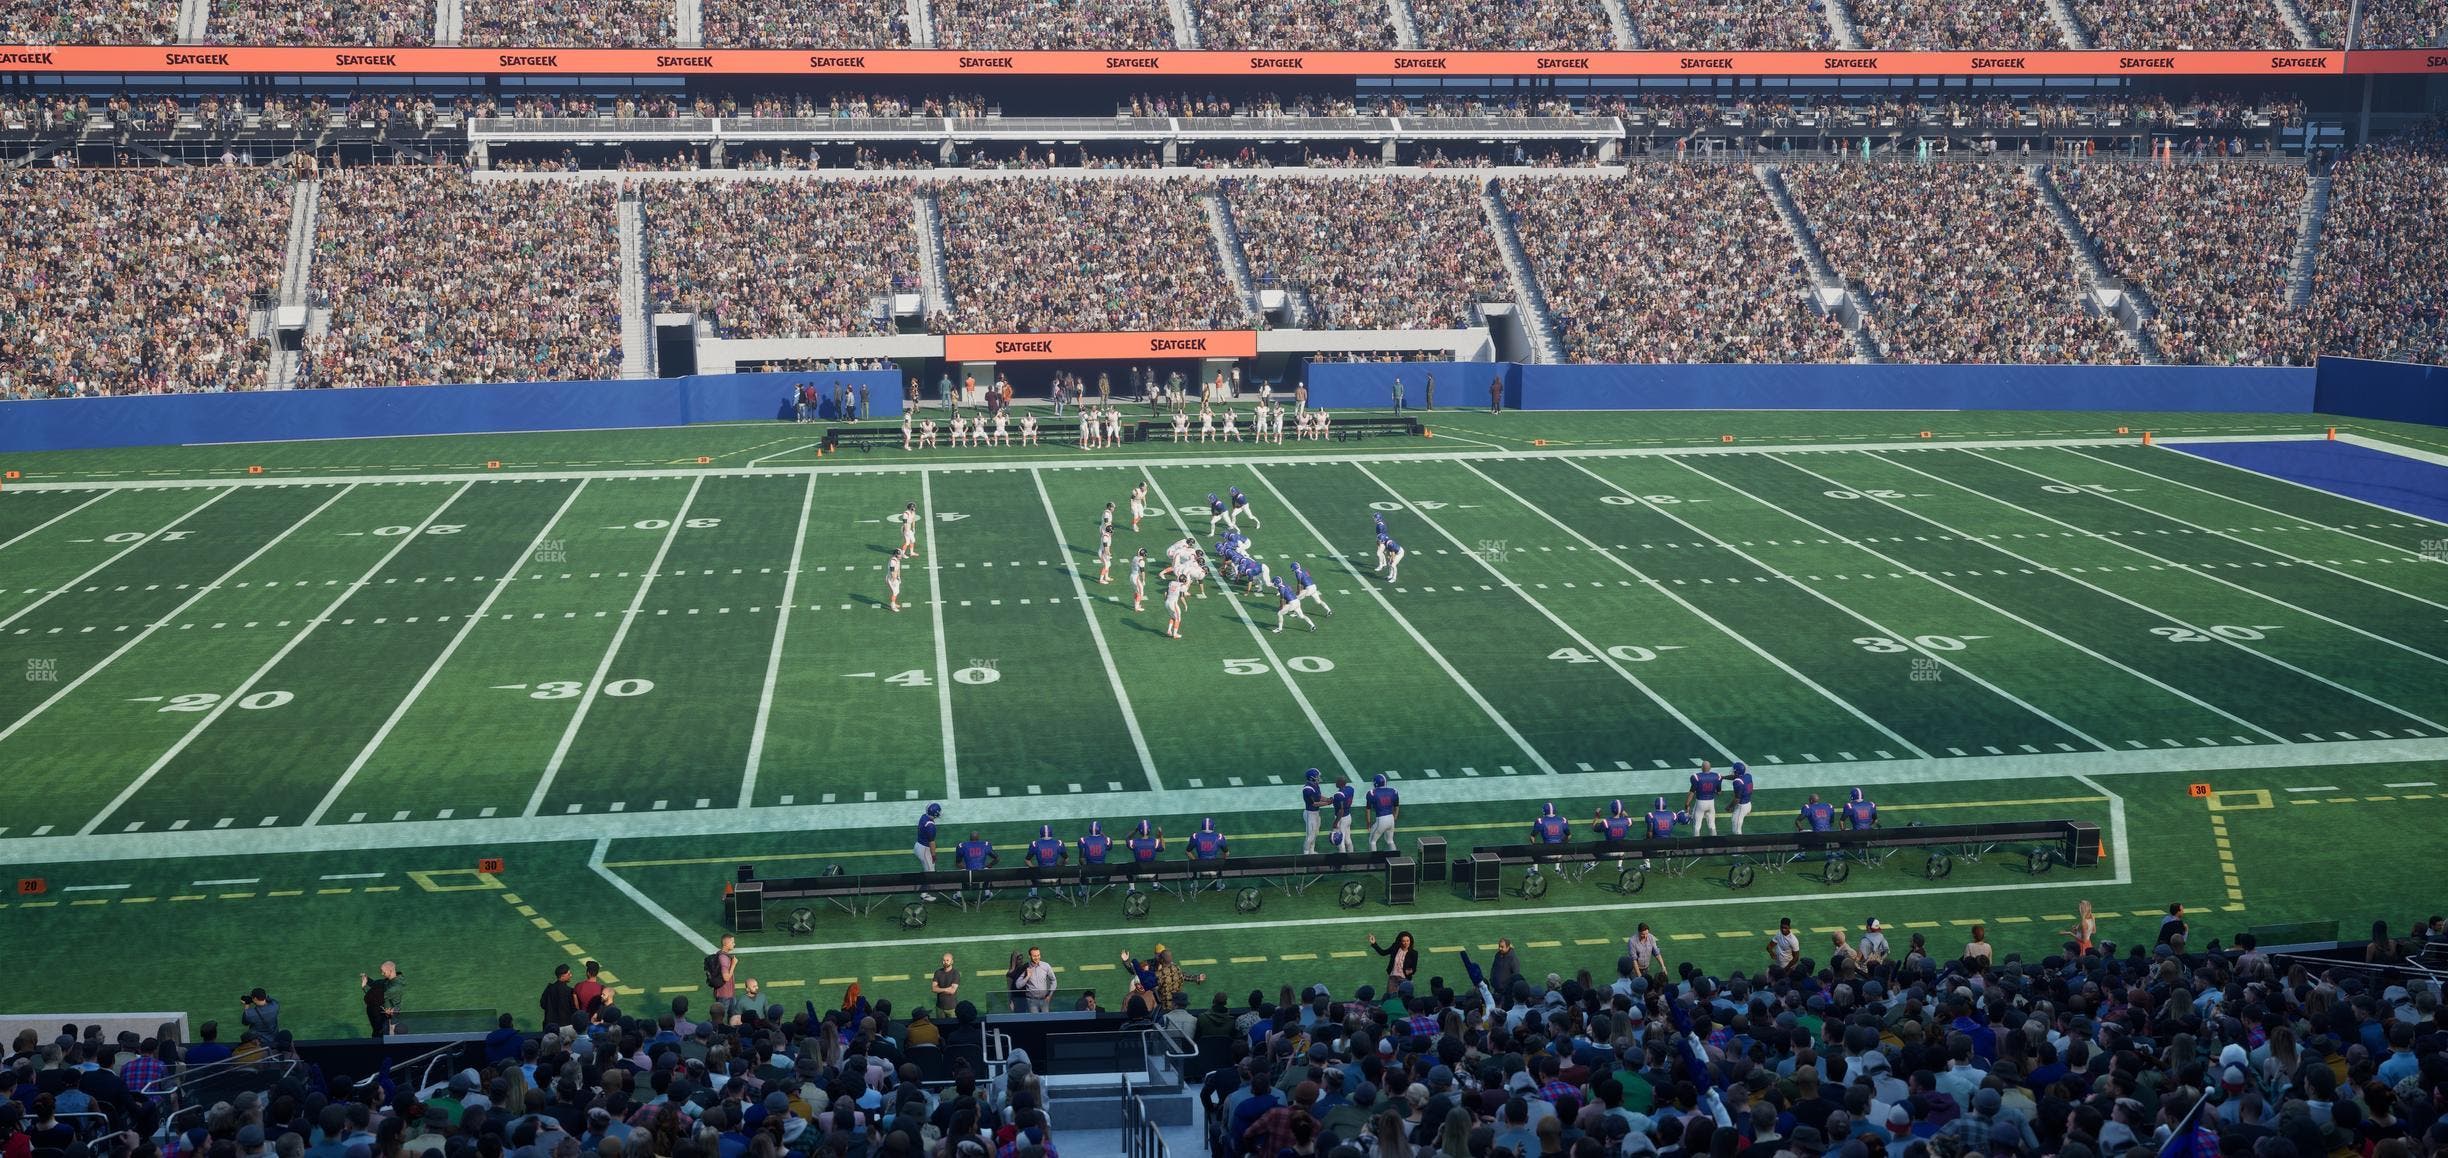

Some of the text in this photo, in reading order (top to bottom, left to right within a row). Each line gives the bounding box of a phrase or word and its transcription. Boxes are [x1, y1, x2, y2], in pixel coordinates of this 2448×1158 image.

[166, 54, 229, 66] SEATGEEK
[336, 55, 396, 66] SEATGEEK
[500, 56, 558, 67] SEATGEEK
[657, 56, 713, 68] SEATGEEK
[811, 57, 865, 68] SEATGEEK
[960, 57, 1013, 68] SEATGEEK
[1107, 58, 1159, 69] SEATGEEK
[1251, 58, 1303, 69] SEATGEEK
[1395, 58, 1446, 69] SEATGEEK
[1538, 58, 1589, 69] SEATGEEK
[1681, 58, 1733, 69] SEATGEEK
[1825, 58, 1878, 69] SEATGEEK
[1972, 58, 2025, 69] SEATGEEK
[2120, 58, 2175, 69] SEATGEEK
[2272, 57, 2327, 68] SEATGEEK
[995, 340, 1052, 354] SEATGEEK
[1151, 338, 1206, 352] SEATGEEK
[2150, 625, 2265, 643] 20
[1852, 635, 1966, 653] 30
[1548, 646, 1656, 664] 40
[1223, 656, 1334, 675] 50
[884, 667, 1001, 687] 40
[530, 678, 655, 700] 30
[158, 690, 295, 712] 20
[2196, 785, 2207, 795] 30
[485, 860, 498, 871] 30
[24, 880, 37, 891] 20
